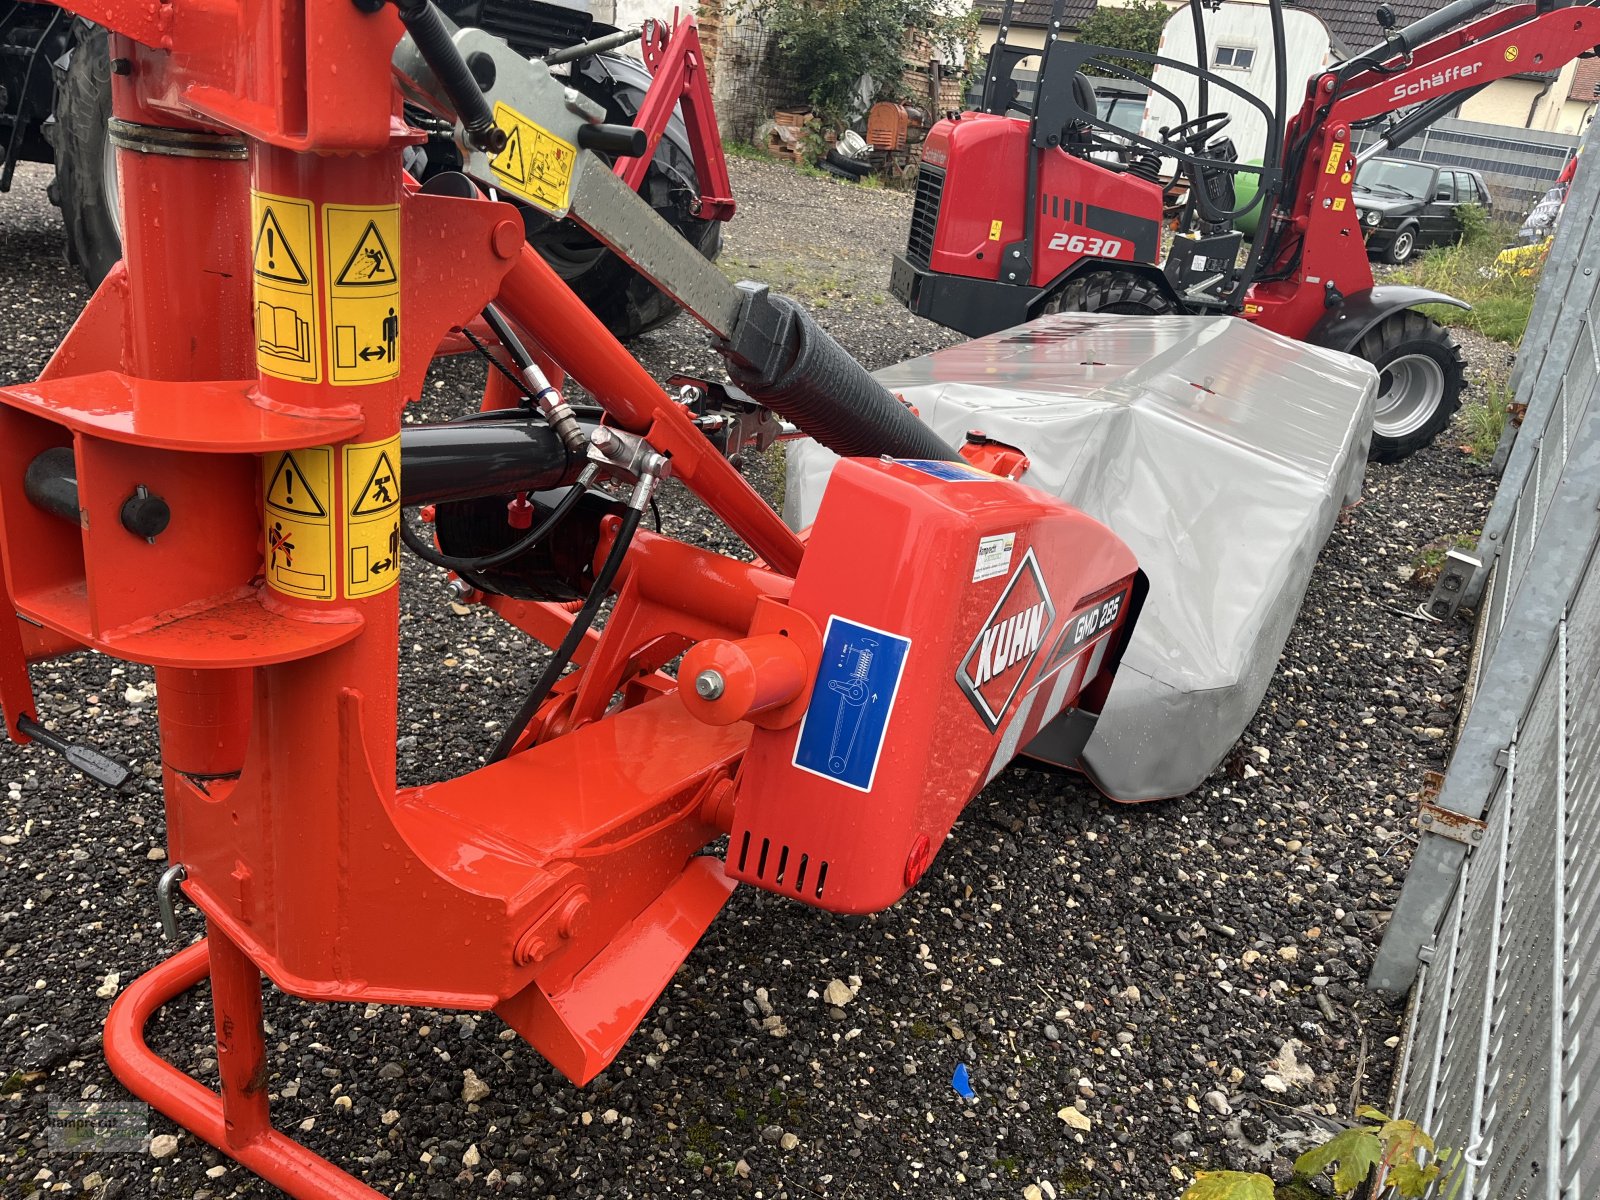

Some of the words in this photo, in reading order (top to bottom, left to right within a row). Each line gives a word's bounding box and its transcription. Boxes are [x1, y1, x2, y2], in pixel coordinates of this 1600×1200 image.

[1389, 62, 1482, 102] Schäffer
[1048, 232, 1121, 258] 2630
[974, 601, 1045, 690] KUHN
[1073, 608, 1100, 645] GMD
